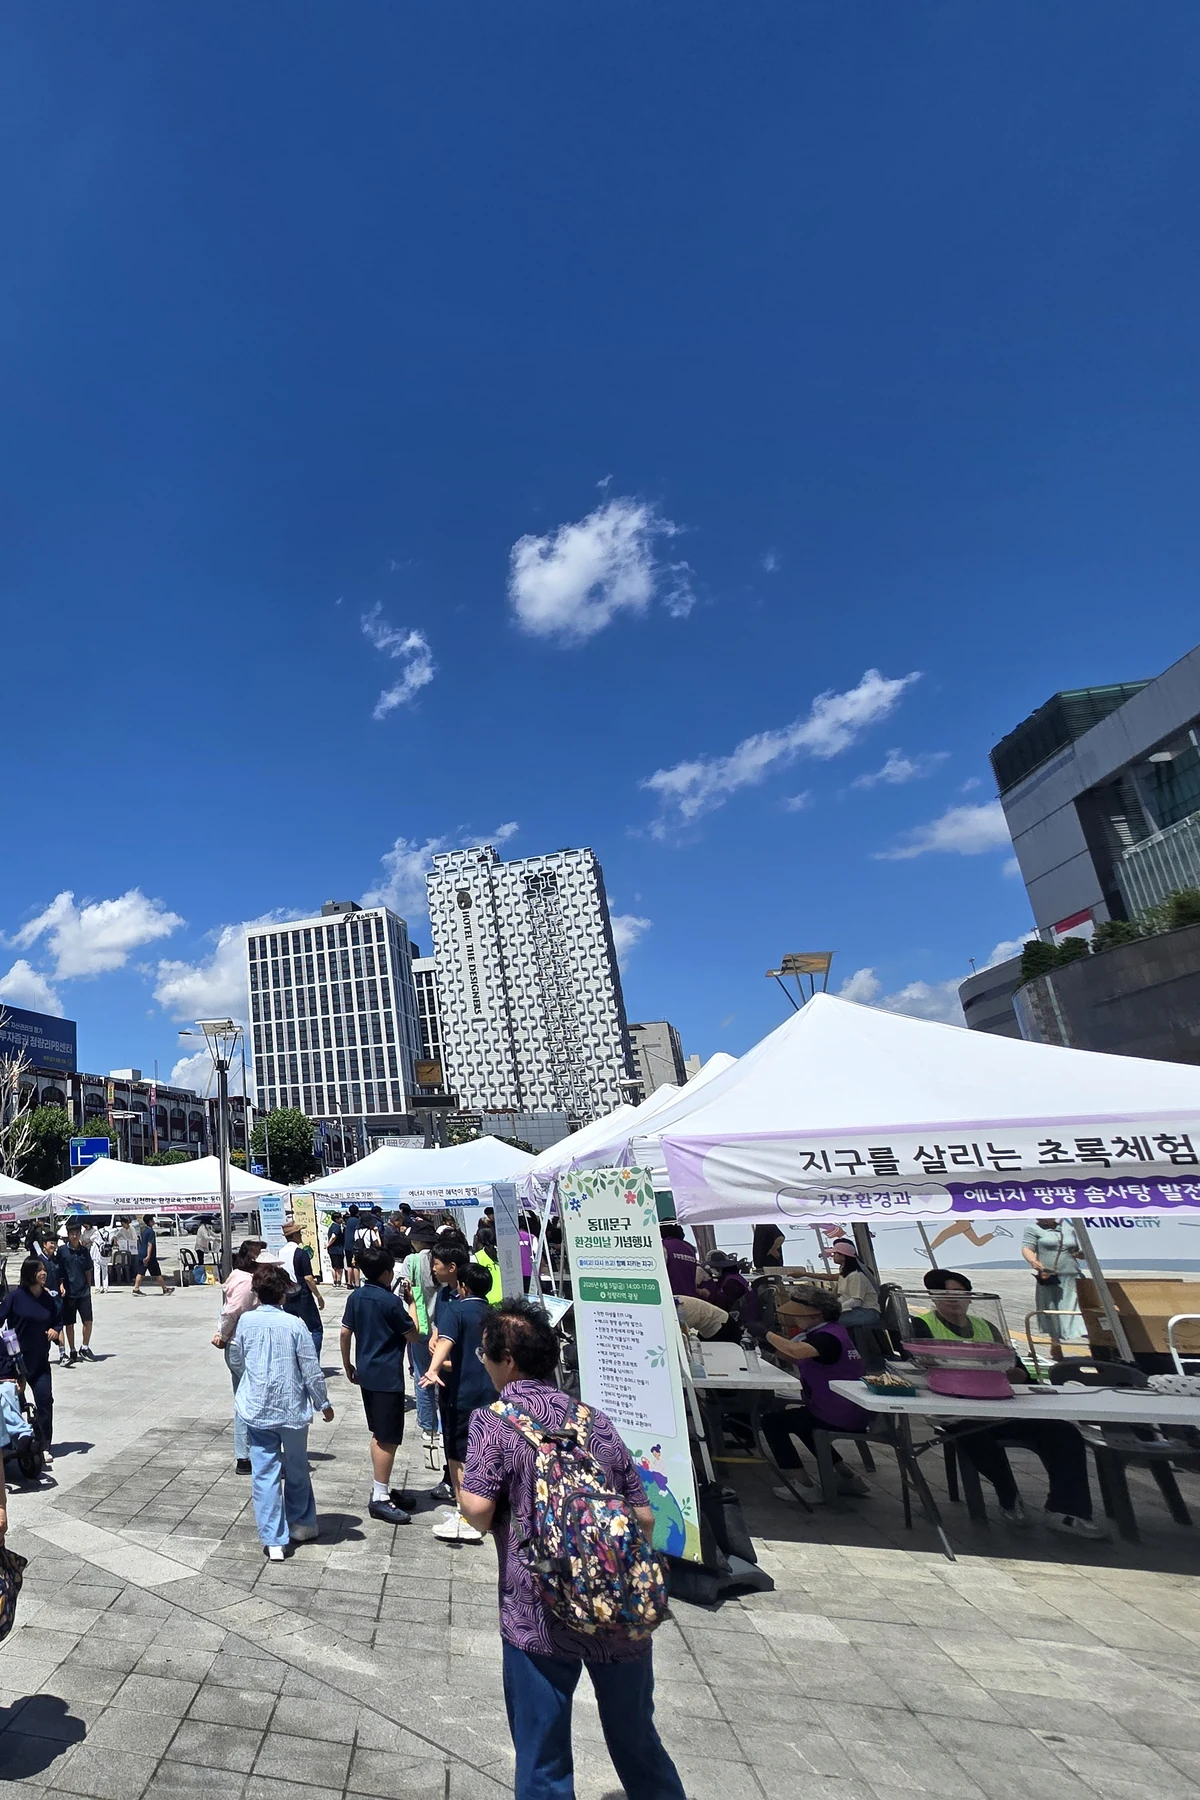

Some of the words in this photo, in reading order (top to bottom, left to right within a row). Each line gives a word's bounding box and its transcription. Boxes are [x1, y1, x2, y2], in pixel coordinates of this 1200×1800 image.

[462, 911, 473, 940] HOTEL
[466, 943, 476, 962] THE
[468, 964, 482, 1015] DESIGNERS
[799, 1147, 900, 1177] 지구를
[913, 1142, 1022, 1175] 살리는
[1038, 1133, 1198, 1168] 초록체험
[818, 1190, 912, 1209] 기후환경과
[963, 1188, 1027, 1204] 에너지
[1033, 1187, 1076, 1205] 팡팡
[1083, 1184, 1151, 1204] 솜사탕
[587, 1217, 631, 1232] 동대문구
[1136, 1220, 1160, 1228] CITY
[575, 1236, 611, 1248] 환경의날
[613, 1235, 652, 1248] 기념행사
